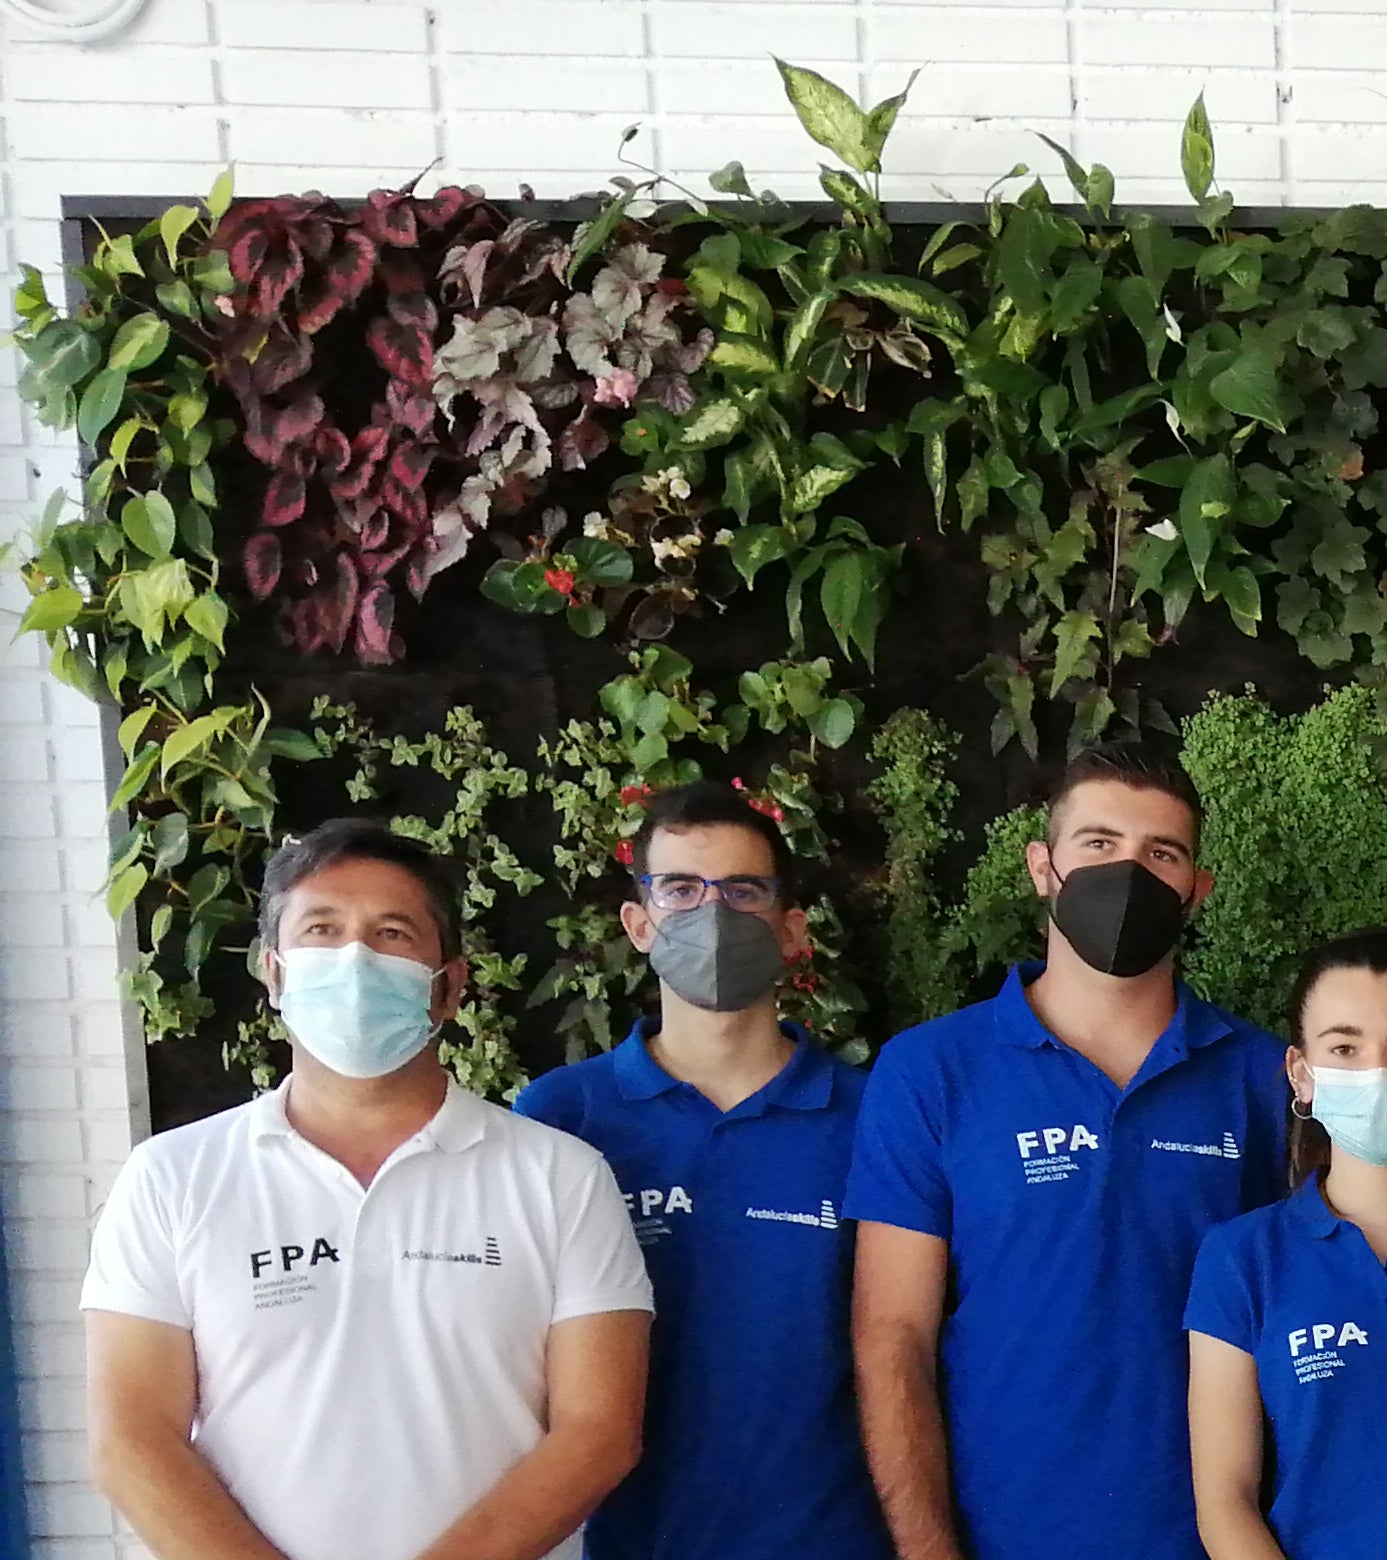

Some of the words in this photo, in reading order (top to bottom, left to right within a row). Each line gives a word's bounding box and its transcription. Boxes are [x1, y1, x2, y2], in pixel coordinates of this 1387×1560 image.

[1016, 1124, 1100, 1158] FPA
[250, 1237, 341, 1279] FPA
[1288, 1321, 1369, 1357] FPA
